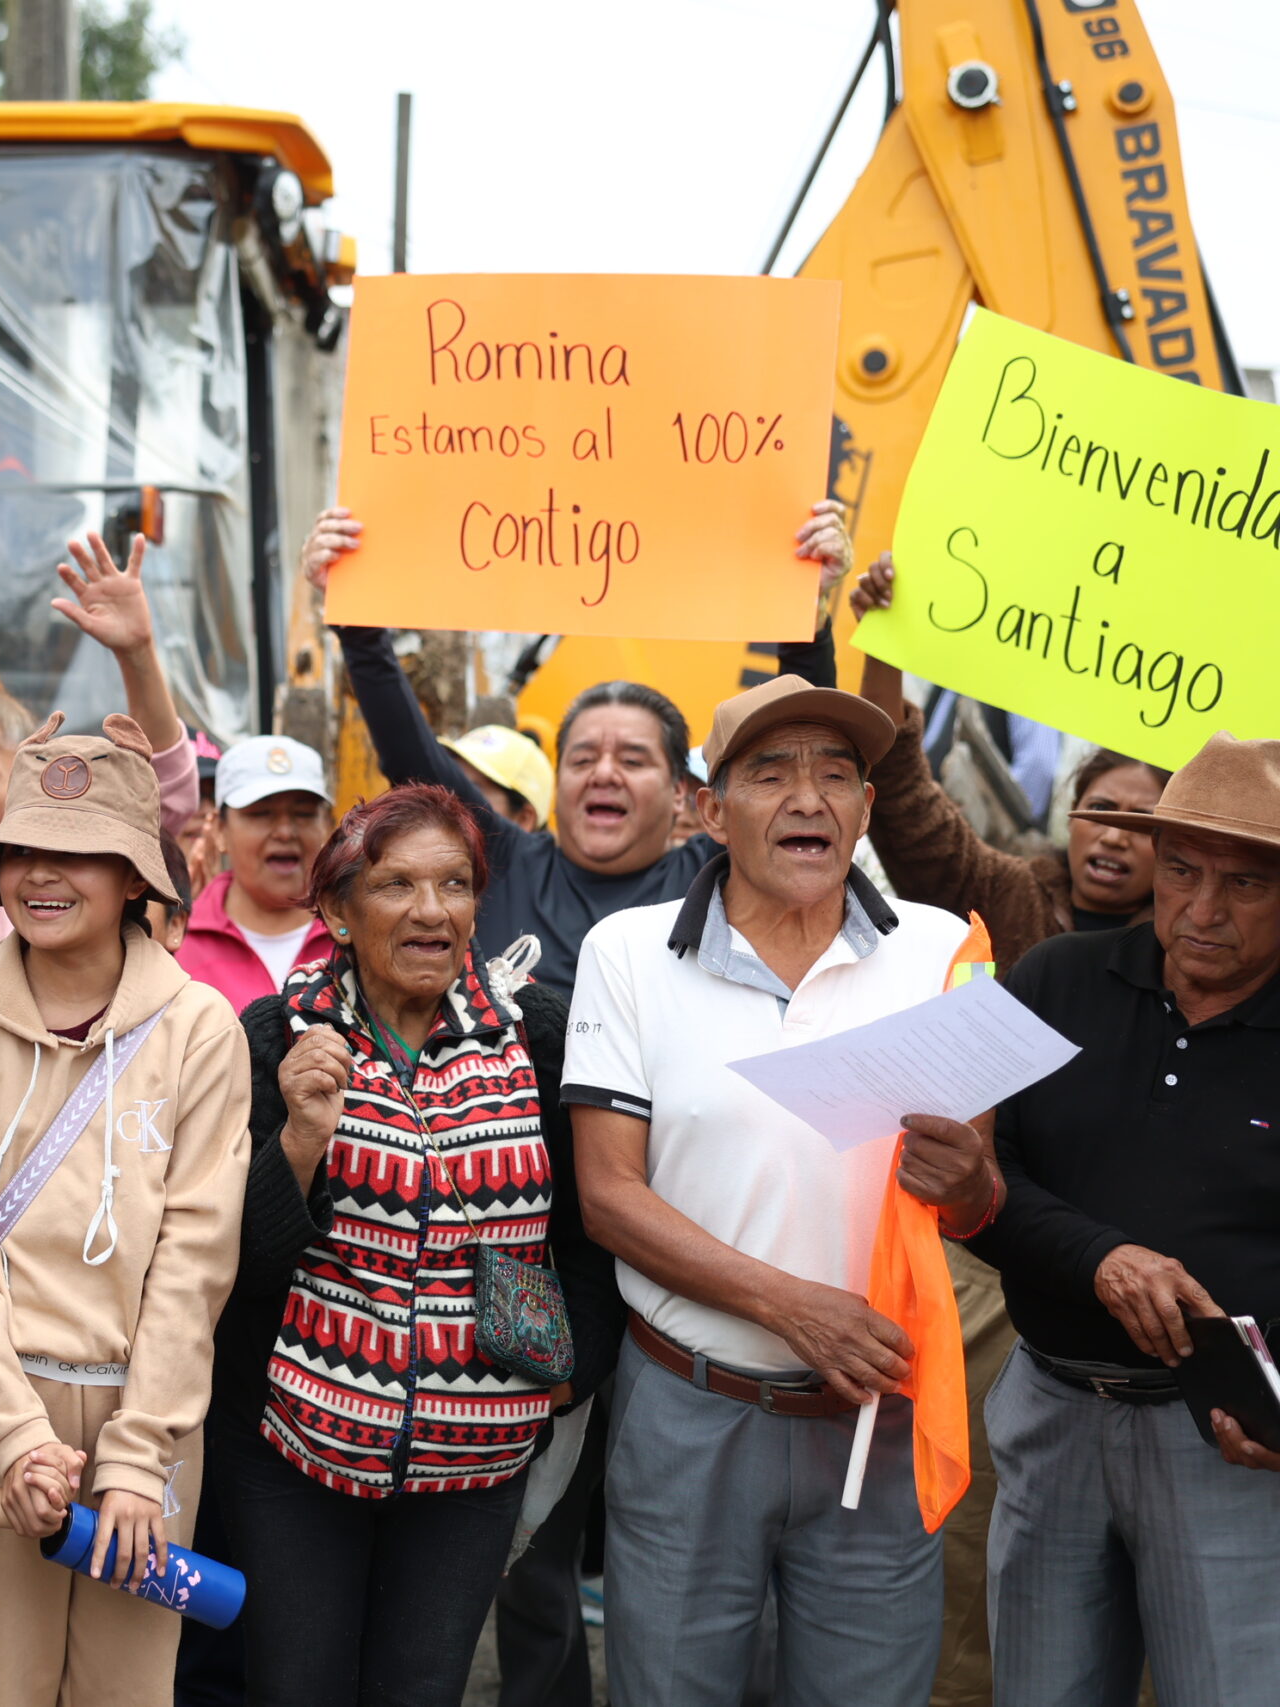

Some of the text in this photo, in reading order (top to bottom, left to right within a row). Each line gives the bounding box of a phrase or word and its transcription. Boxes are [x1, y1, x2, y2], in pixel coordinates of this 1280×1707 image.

[1083, 16, 1130, 61] 96
[1114, 122, 1202, 387] BRAVAD
[426, 298, 631, 387] Romina
[370, 405, 786, 465] Estamos al 100%
[1092, 540, 1126, 585] a
[927, 526, 1224, 729] Santiago
